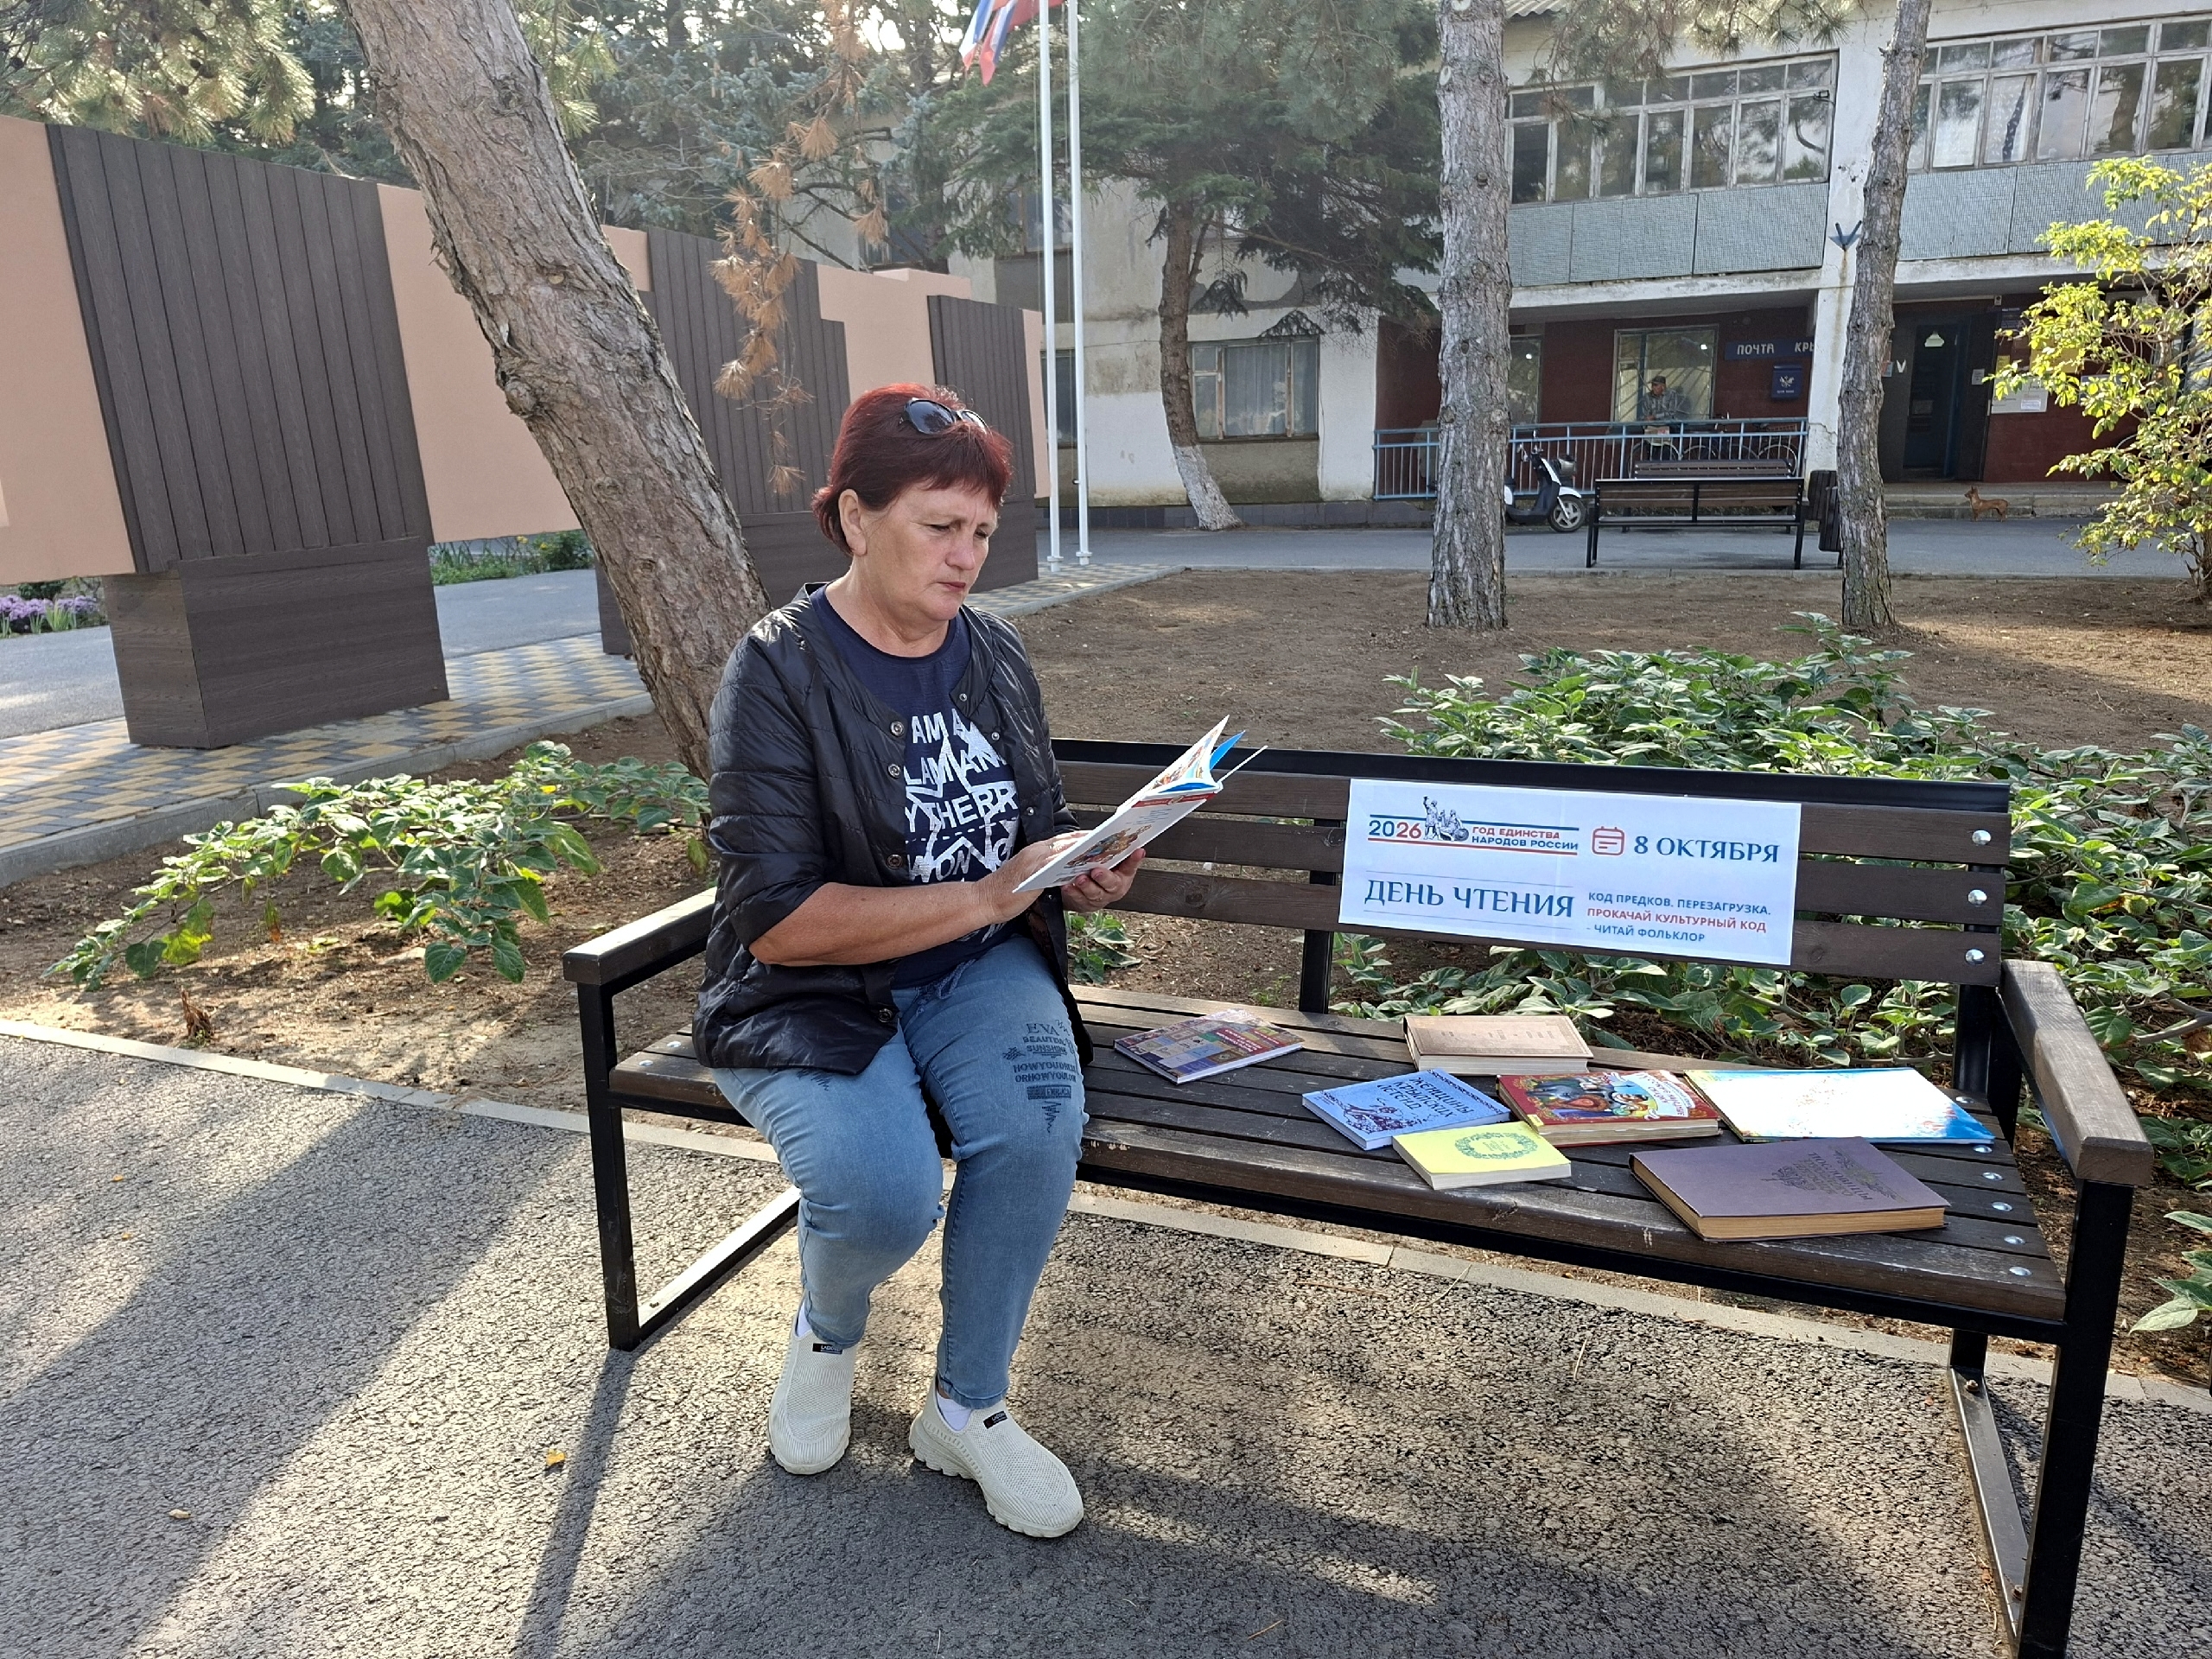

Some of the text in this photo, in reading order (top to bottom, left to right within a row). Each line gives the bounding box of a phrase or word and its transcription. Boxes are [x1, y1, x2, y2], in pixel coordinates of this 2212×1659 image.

[1737, 343, 1774, 354] ПОЧТА
[1369, 820, 1421, 838] 2026
[1472, 826, 1560, 839] ГОД ЕДИНСТВА
[1471, 836, 1579, 850] НАРОДОВ РОССИИ
[1634, 836, 1780, 862] 8 ОКТЯБРЯ
[1364, 880, 1575, 918] ДЕНЬ ЧТЕНИЯ
[1588, 892, 1771, 915] КОД ПРЕДКОВ. ПЕРЕЗАГРУЗКА.
[1587, 908, 1766, 933] ПРОКАЧАЙ КУЛЬТУРНЫЙ КОД
[1594, 925, 1634, 936] ЧИТАЙ
[1637, 928, 1705, 942] ФОЛЬКЛОР
[1027, 1023, 1059, 1036] EVA
[1377, 1084, 1421, 1109] ЛЕГЕНД
[1394, 1081, 1458, 1117] КРЫМСКИХ
[1409, 1077, 1474, 1114] ЖЕНЩИНЫ
